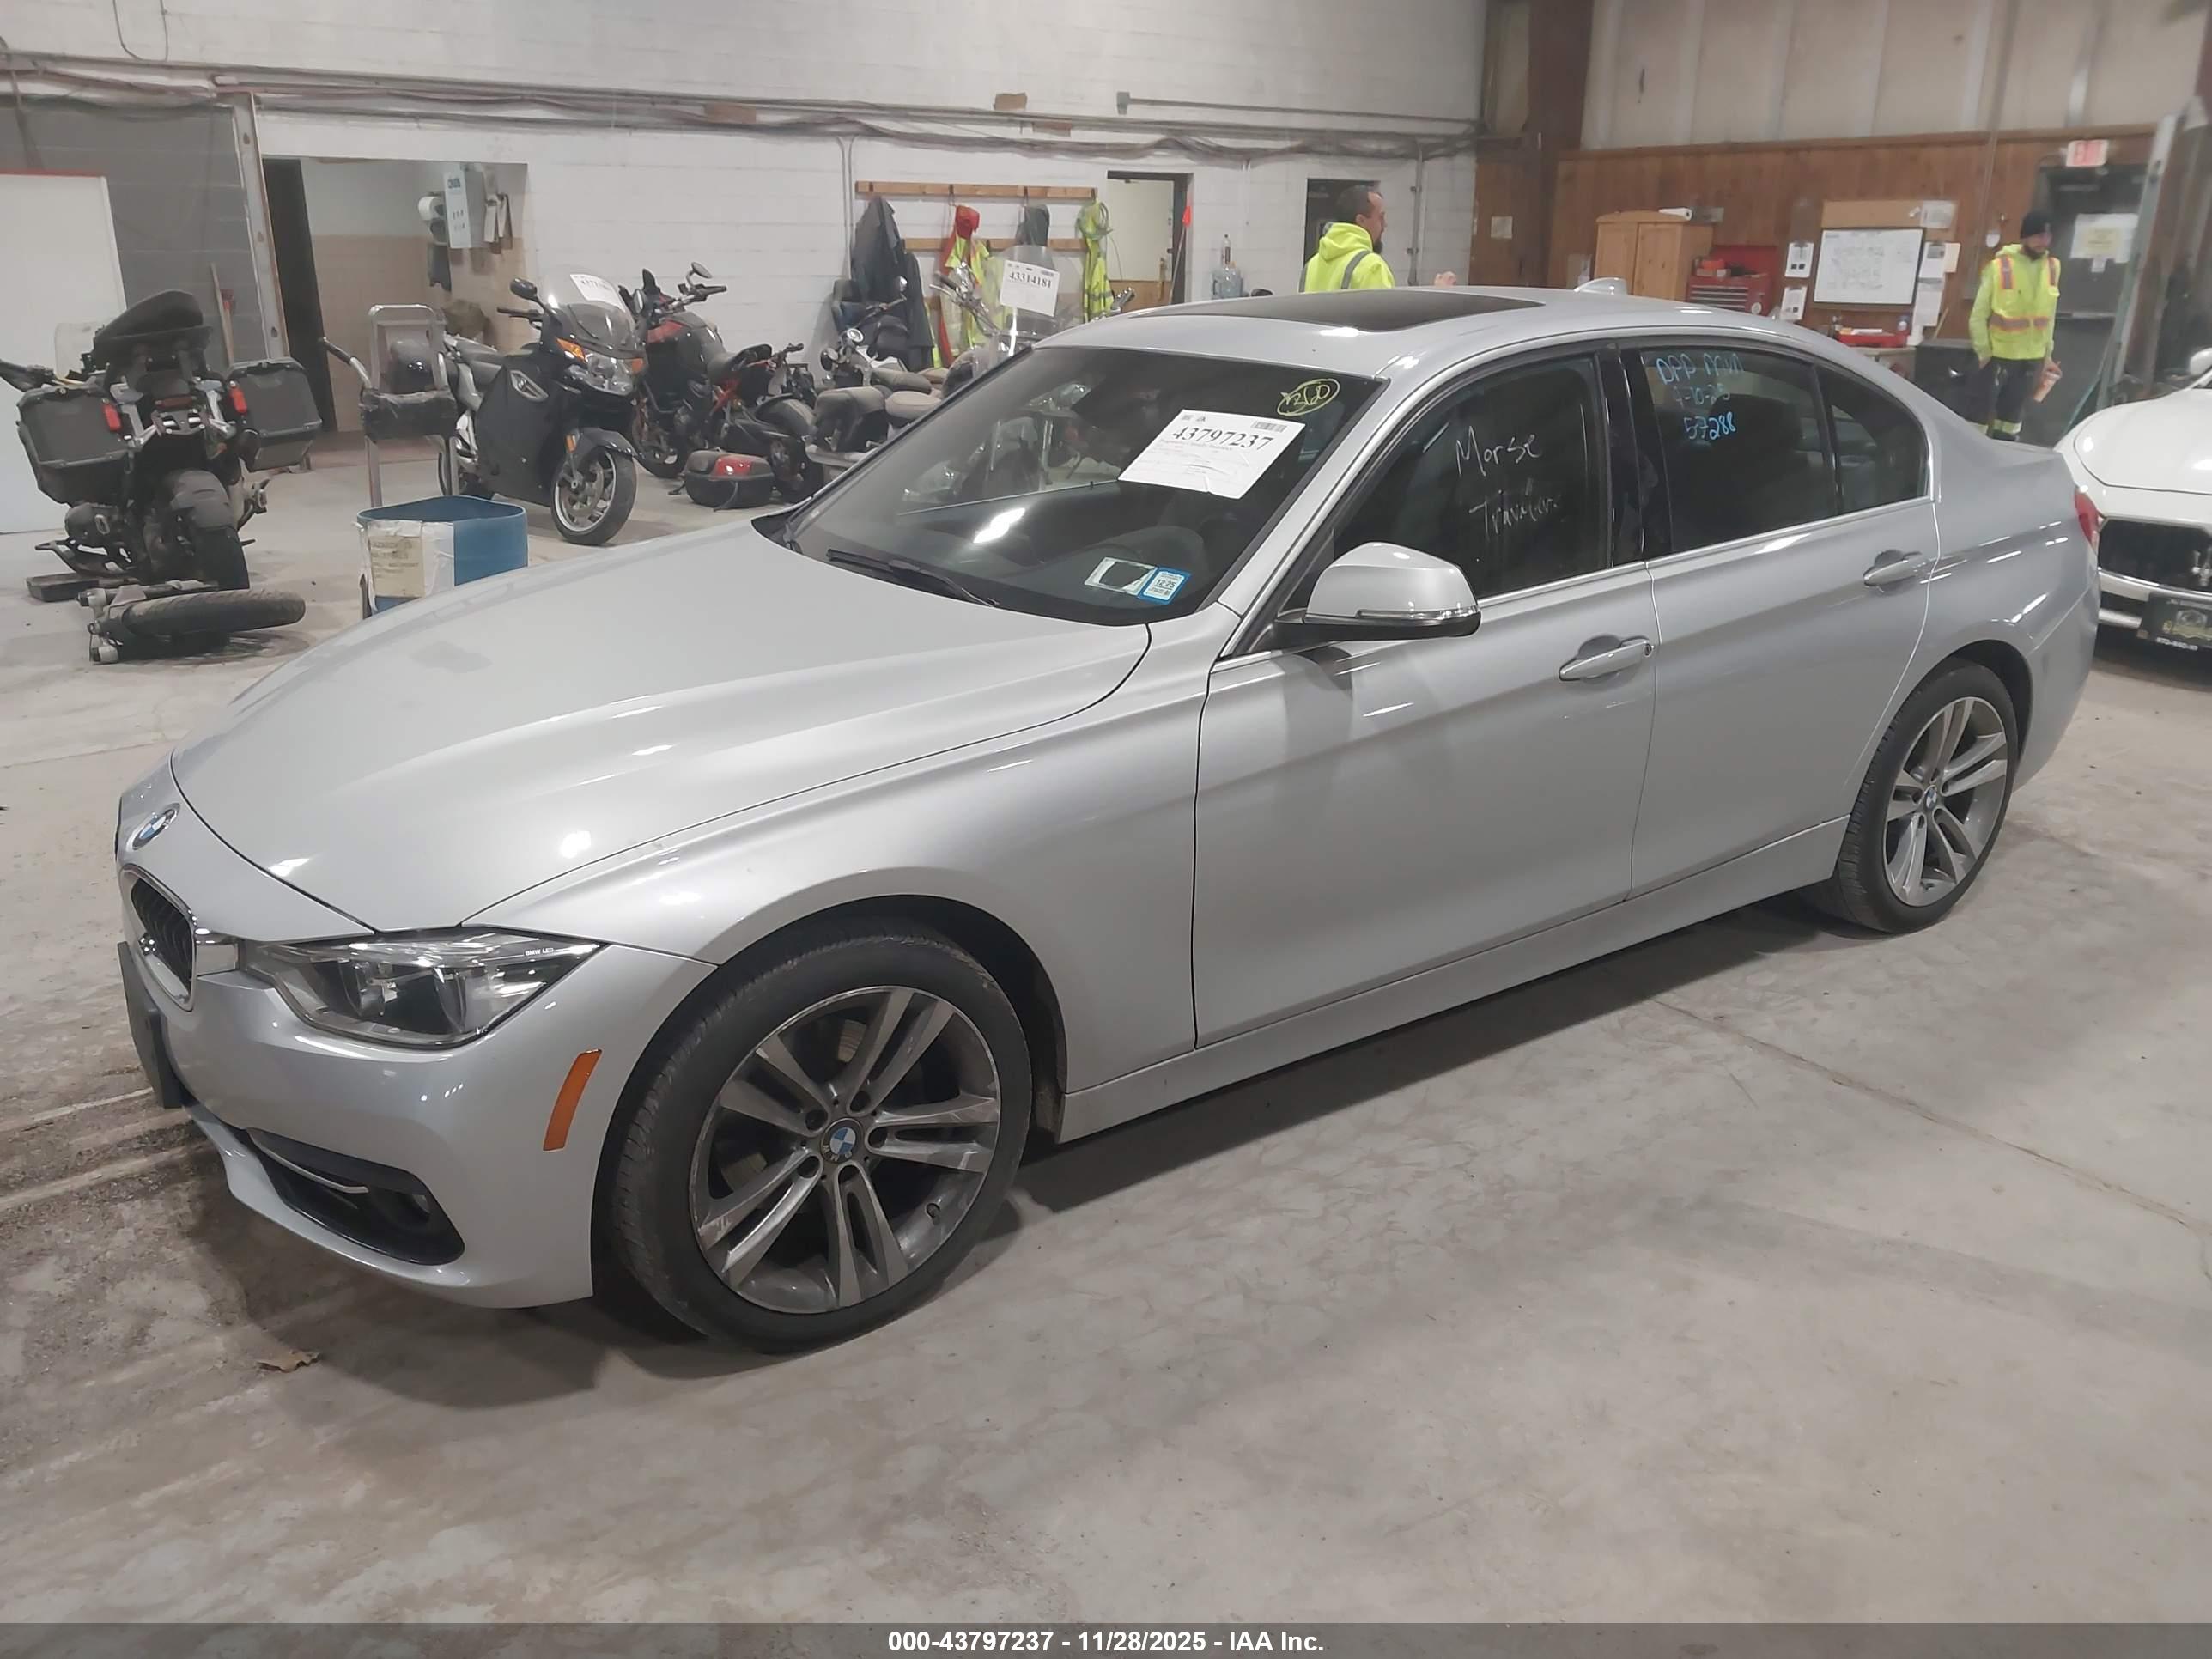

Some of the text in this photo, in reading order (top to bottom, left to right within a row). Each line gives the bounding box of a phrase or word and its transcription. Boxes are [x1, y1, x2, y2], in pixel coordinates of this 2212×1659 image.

[1009, 271, 1051, 289] 43314181
[1172, 426, 1273, 451] 43797237
[1683, 411, 1736, 440] 57288
[1455, 425, 1542, 477] Morse
